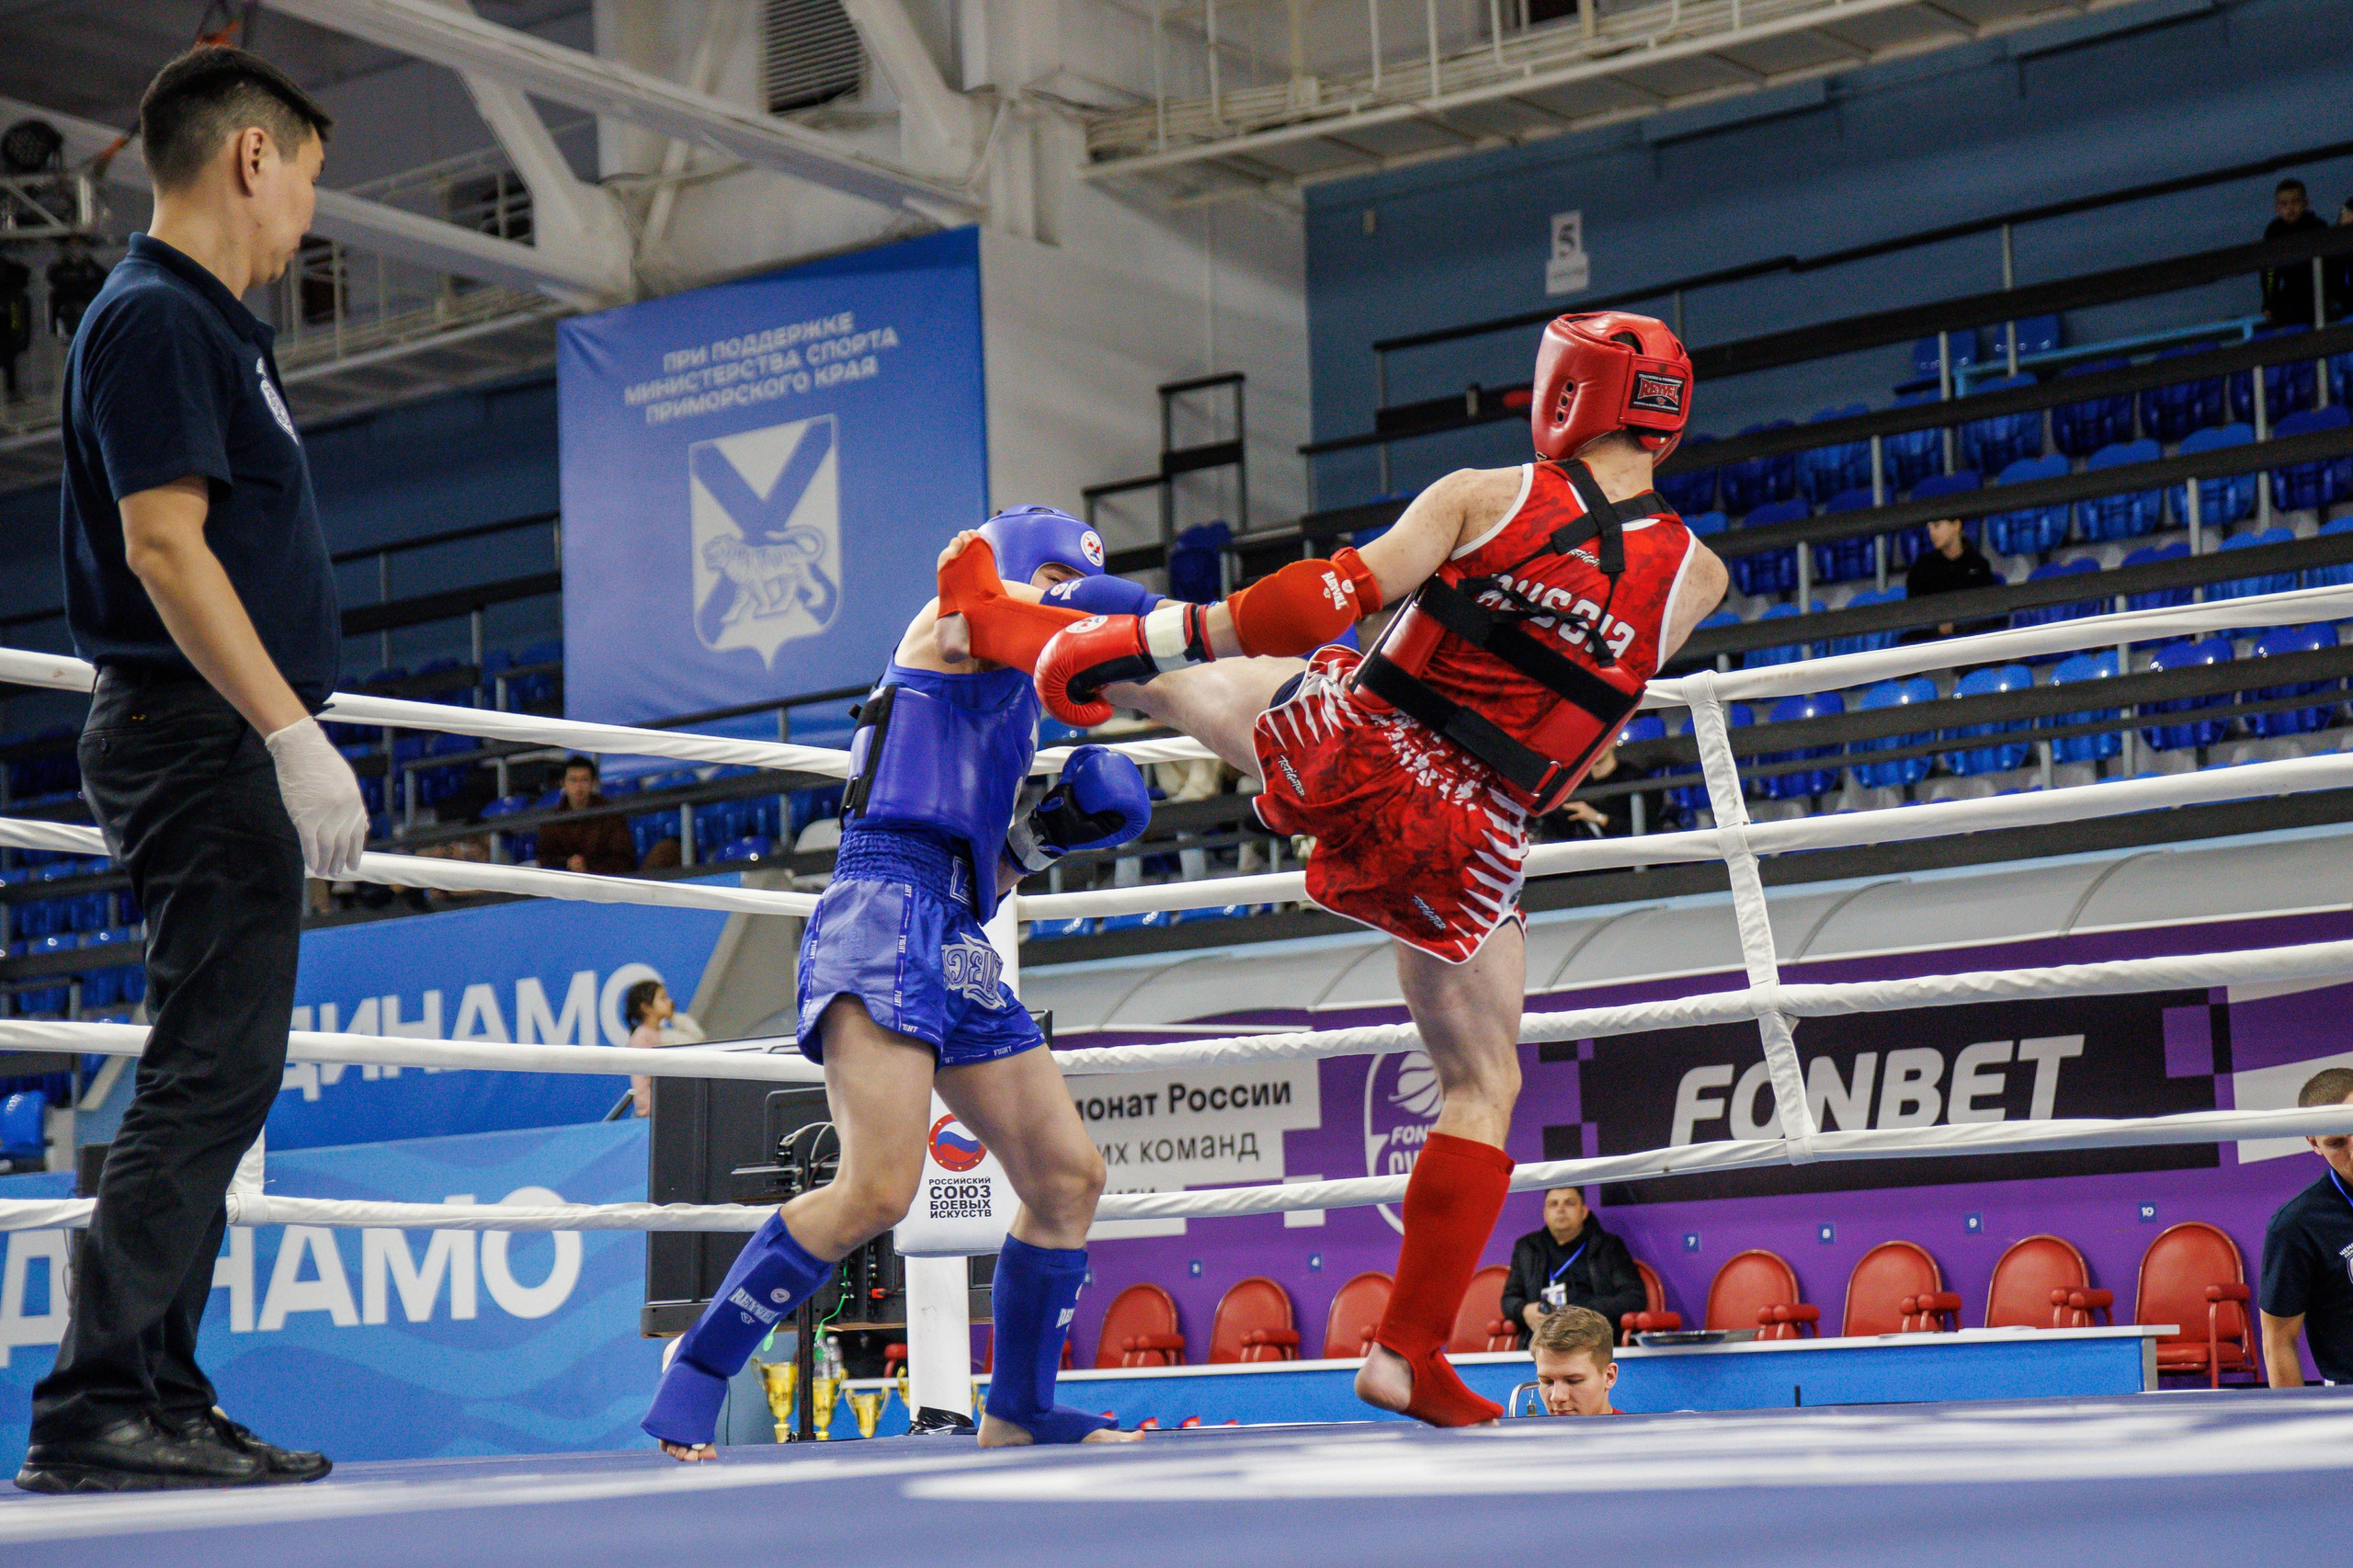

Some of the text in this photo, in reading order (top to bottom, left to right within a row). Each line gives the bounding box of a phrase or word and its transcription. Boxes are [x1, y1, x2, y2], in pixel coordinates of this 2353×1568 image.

[663, 311, 855, 373] ПРИ ПОДДЕРЖКЕ
[623, 325, 900, 405] МИНИСТЕРСТВА СПОРТА
[645, 355, 879, 425] ПРИМОРСКОГО КРАЯ
[809, 939, 819, 960] FIGHT
[897, 934, 907, 954] FIGHT
[993, 1045, 1013, 1057] FIGHT
[1075, 1080, 1291, 1120] ионат России
[1669, 1033, 2086, 1148] FONBET
[1390, 1124, 1434, 1146] FON
[1140, 1131, 1260, 1164] команд
[928, 1176, 991, 1186] РОССИЙСКИЙ
[929, 1185, 992, 1199] СОЮЗ
[930, 1199, 991, 1210] БОЕВЫХ
[930, 1209, 992, 1219] ИСКУССТВ
[2141, 1206, 2154, 1217] 10
[1688, 1236, 1696, 1247] 7
[0, 1187, 584, 1367] ДНАМО
